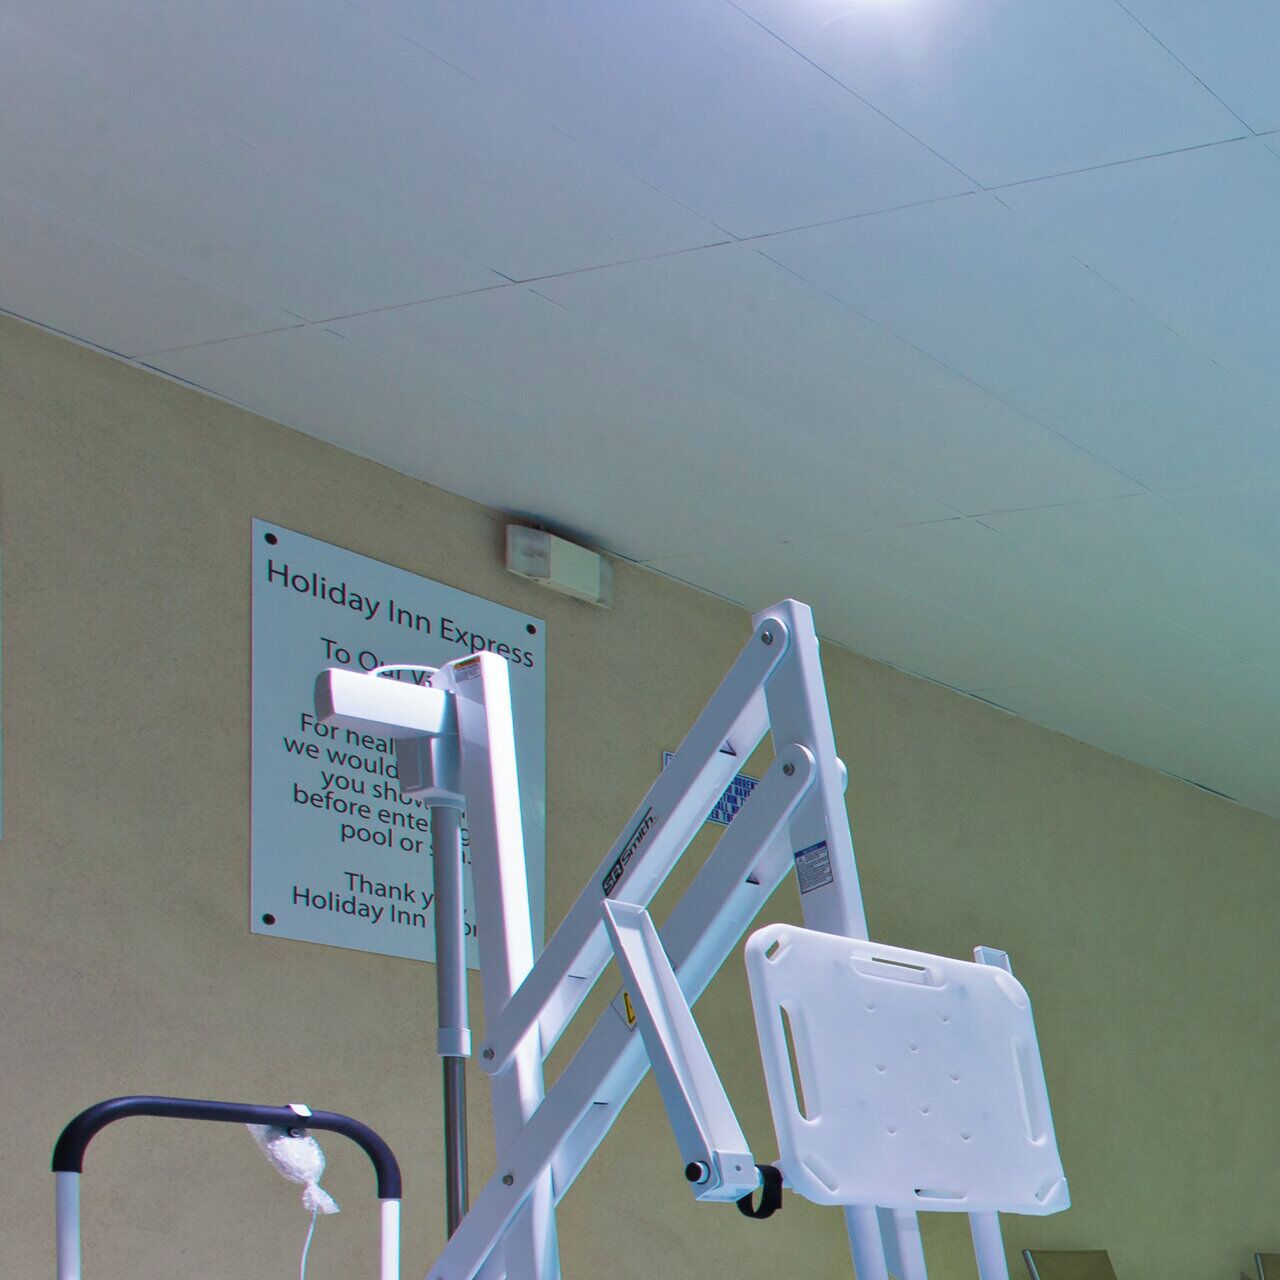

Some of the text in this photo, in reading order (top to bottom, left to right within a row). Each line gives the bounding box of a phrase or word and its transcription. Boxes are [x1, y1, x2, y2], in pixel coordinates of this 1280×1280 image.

[267, 558, 535, 668] Holiday Inn Express
[320, 637, 351, 665] To
[301, 712, 340, 740] For
[283, 736, 400, 779] we would
[321, 770, 366, 795] you
[293, 782, 371, 819] before
[340, 822, 394, 848] pool
[399, 837, 424, 854] or
[621, 814, 656, 867] Smith
[344, 870, 416, 903] Thank
[292, 885, 385, 925] Holiday
[390, 904, 427, 929] Inn
